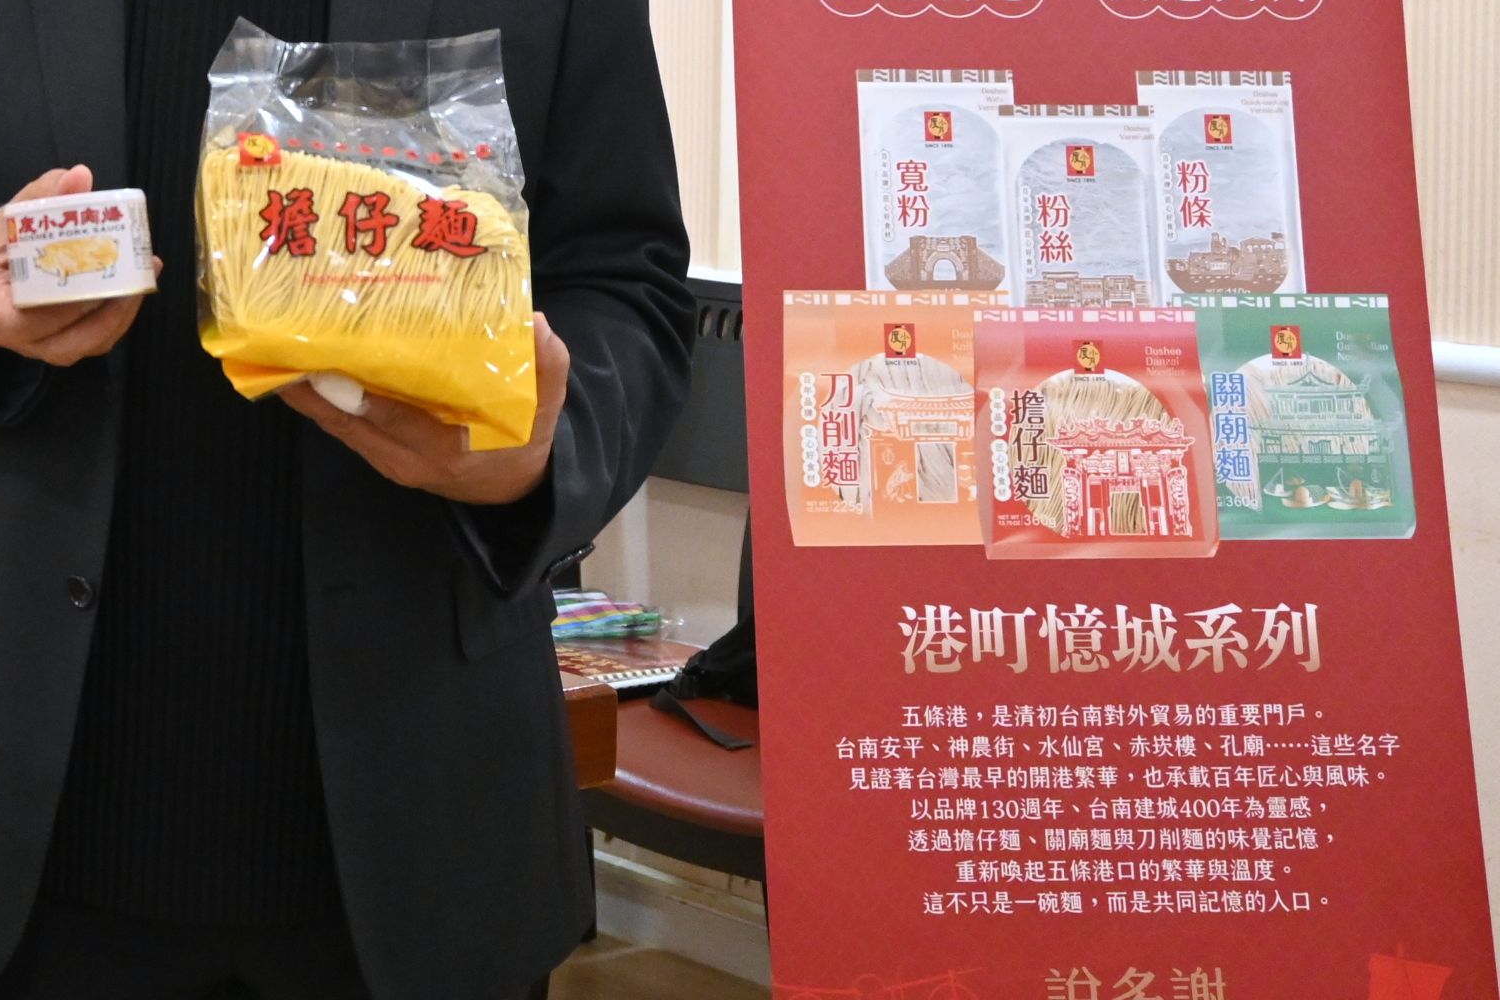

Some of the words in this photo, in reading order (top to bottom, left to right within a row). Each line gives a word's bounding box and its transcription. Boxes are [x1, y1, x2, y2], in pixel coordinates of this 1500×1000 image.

[259, 187, 489, 258] 擔仔麵
[896, 159, 930, 228] 寬粉
[1036, 194, 1074, 264] 粉絲
[1176, 161, 1212, 229] 粉條
[820, 373, 860, 487] 刀削麵
[1010, 389, 1050, 500] 擔仔麵
[1211, 372, 1253, 483] 關廟麵
[897, 601, 1322, 675] 港町憶城系列
